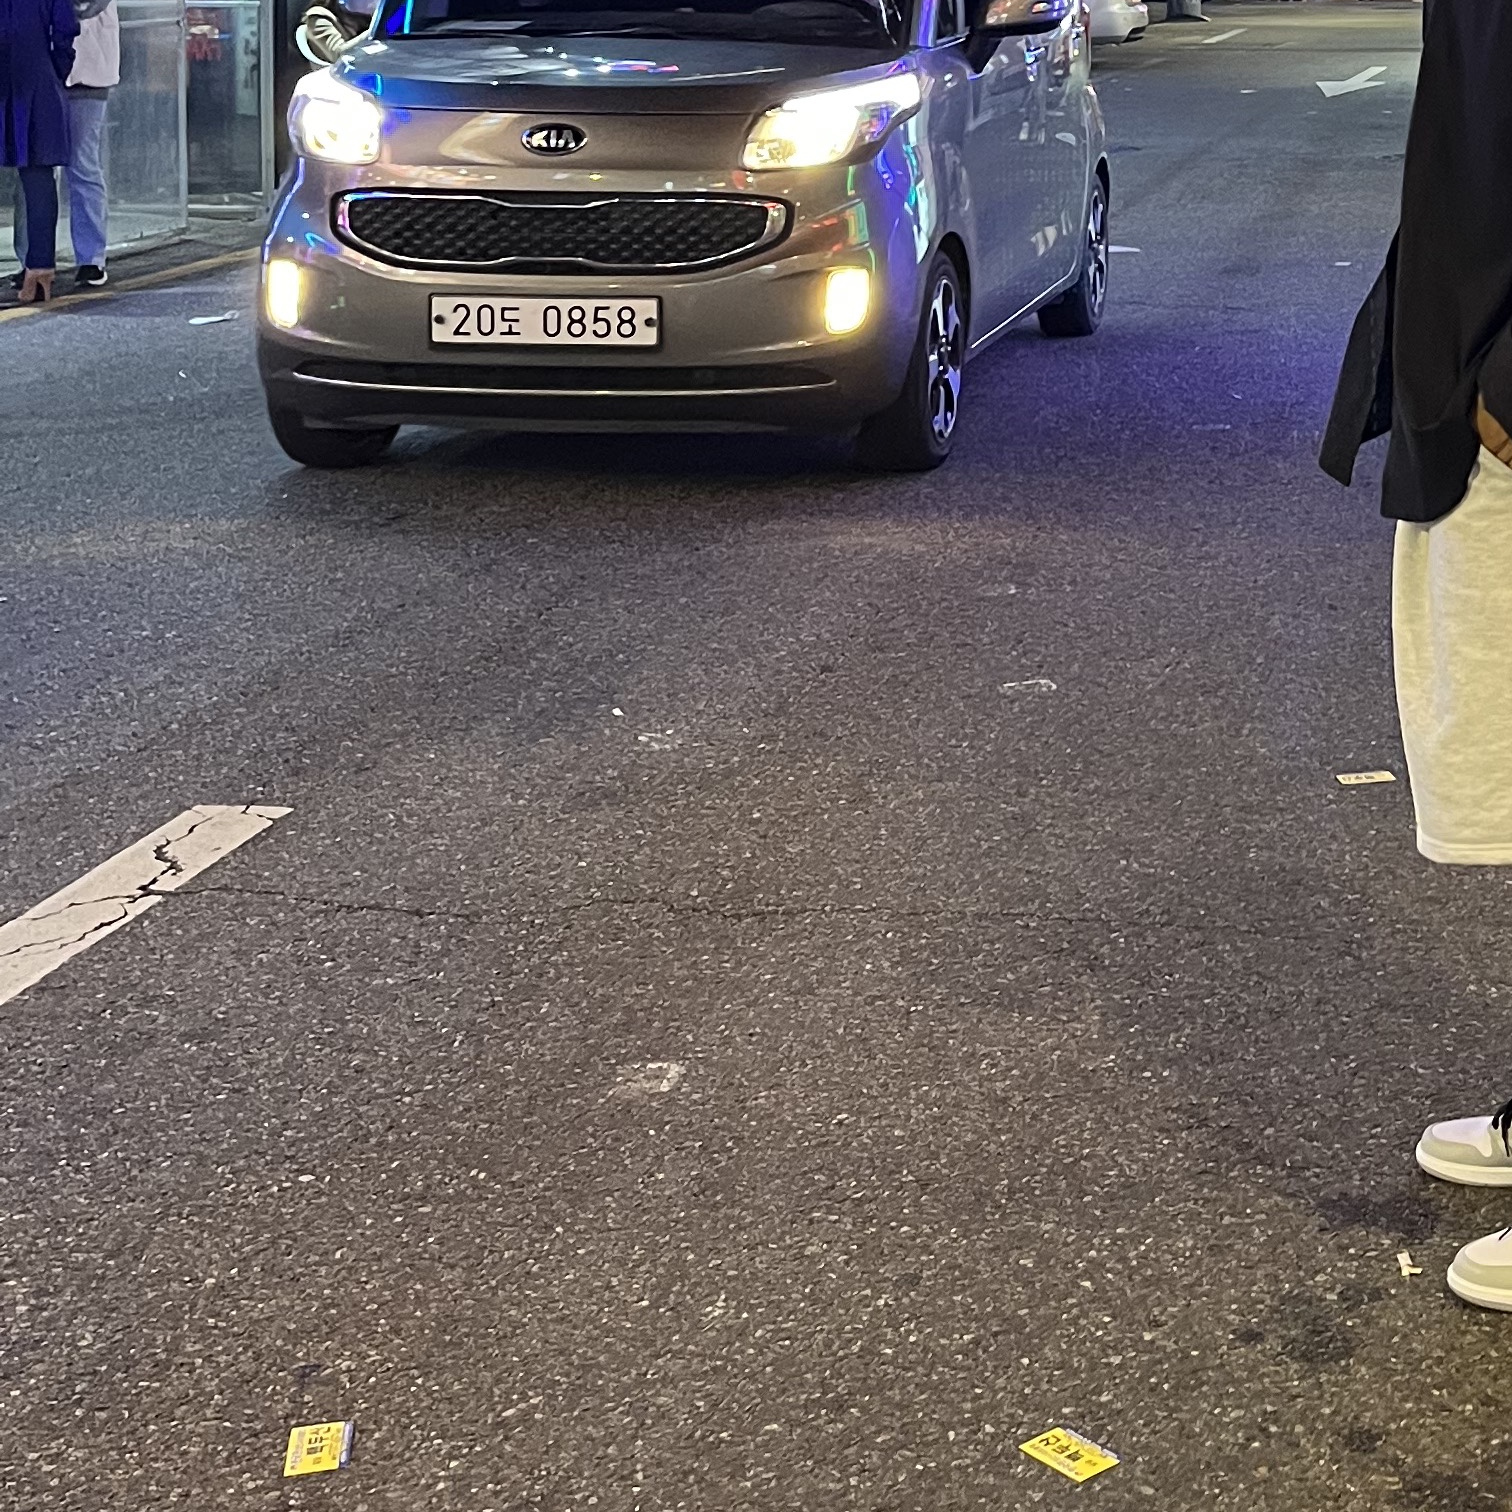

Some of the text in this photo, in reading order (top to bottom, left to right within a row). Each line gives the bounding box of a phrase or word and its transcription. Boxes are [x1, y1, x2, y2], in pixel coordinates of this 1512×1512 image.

[530, 130, 576, 149] KIA
[451, 303, 637, 339] 20도 0858
